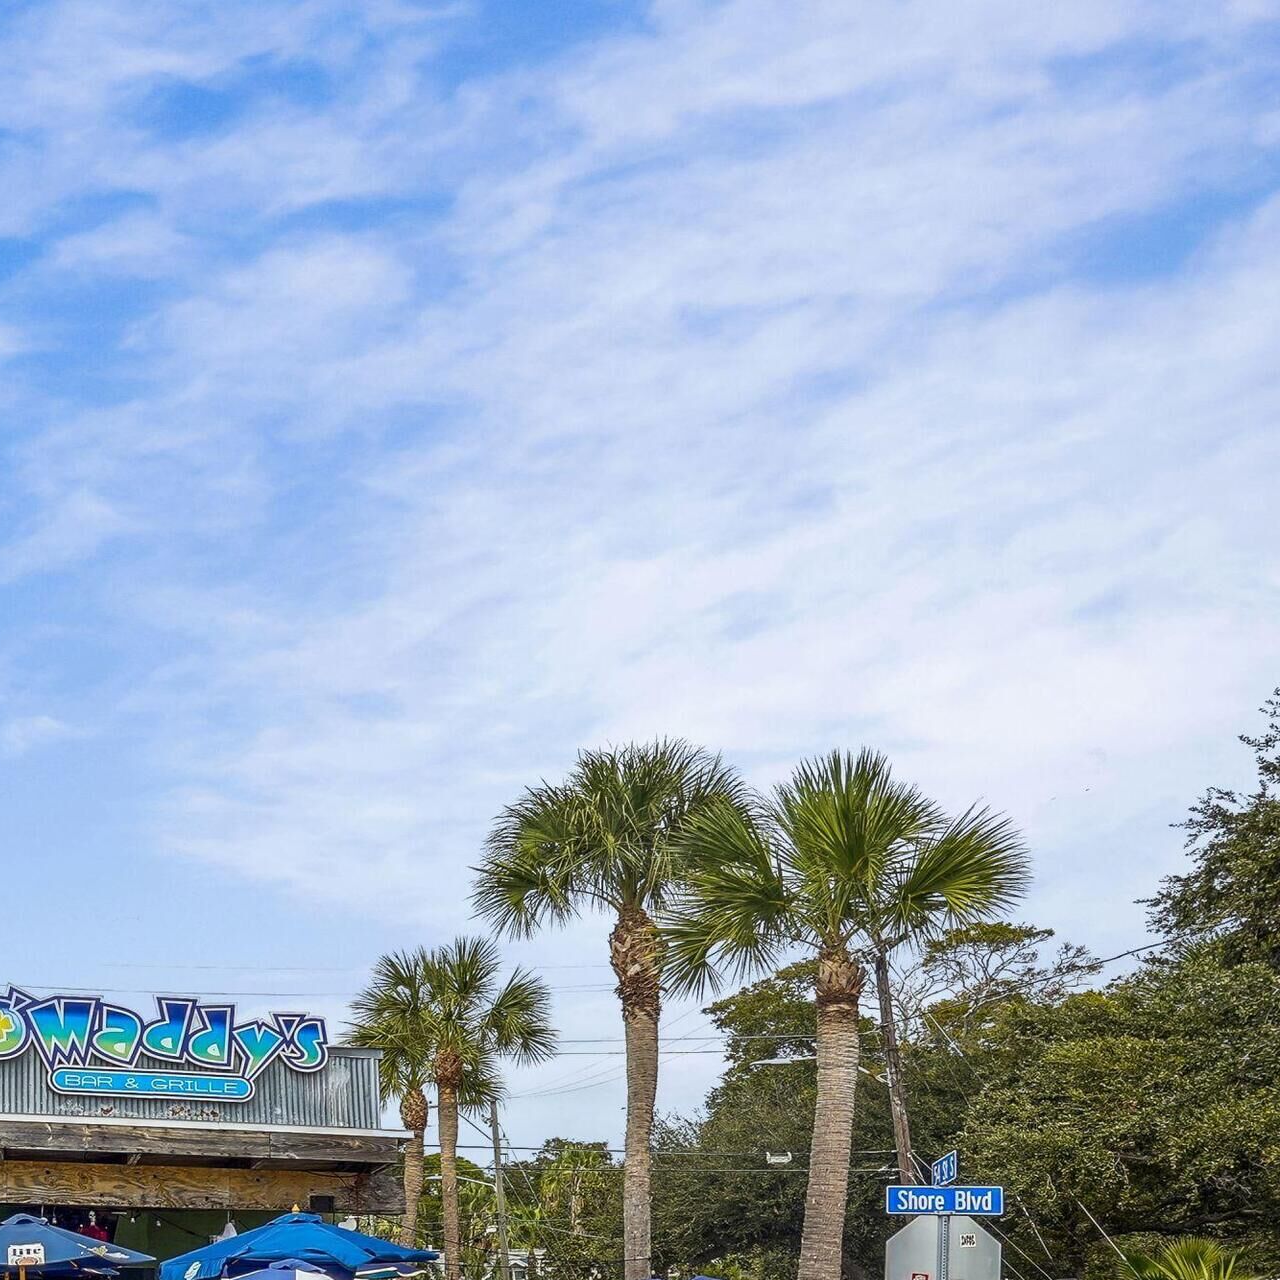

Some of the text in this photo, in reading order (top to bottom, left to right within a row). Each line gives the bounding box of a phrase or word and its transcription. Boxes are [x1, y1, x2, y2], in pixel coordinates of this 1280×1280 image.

[65, 1074, 240, 1094] BAR & GRILLE
[897, 1190, 992, 1211] Shore Blvd
